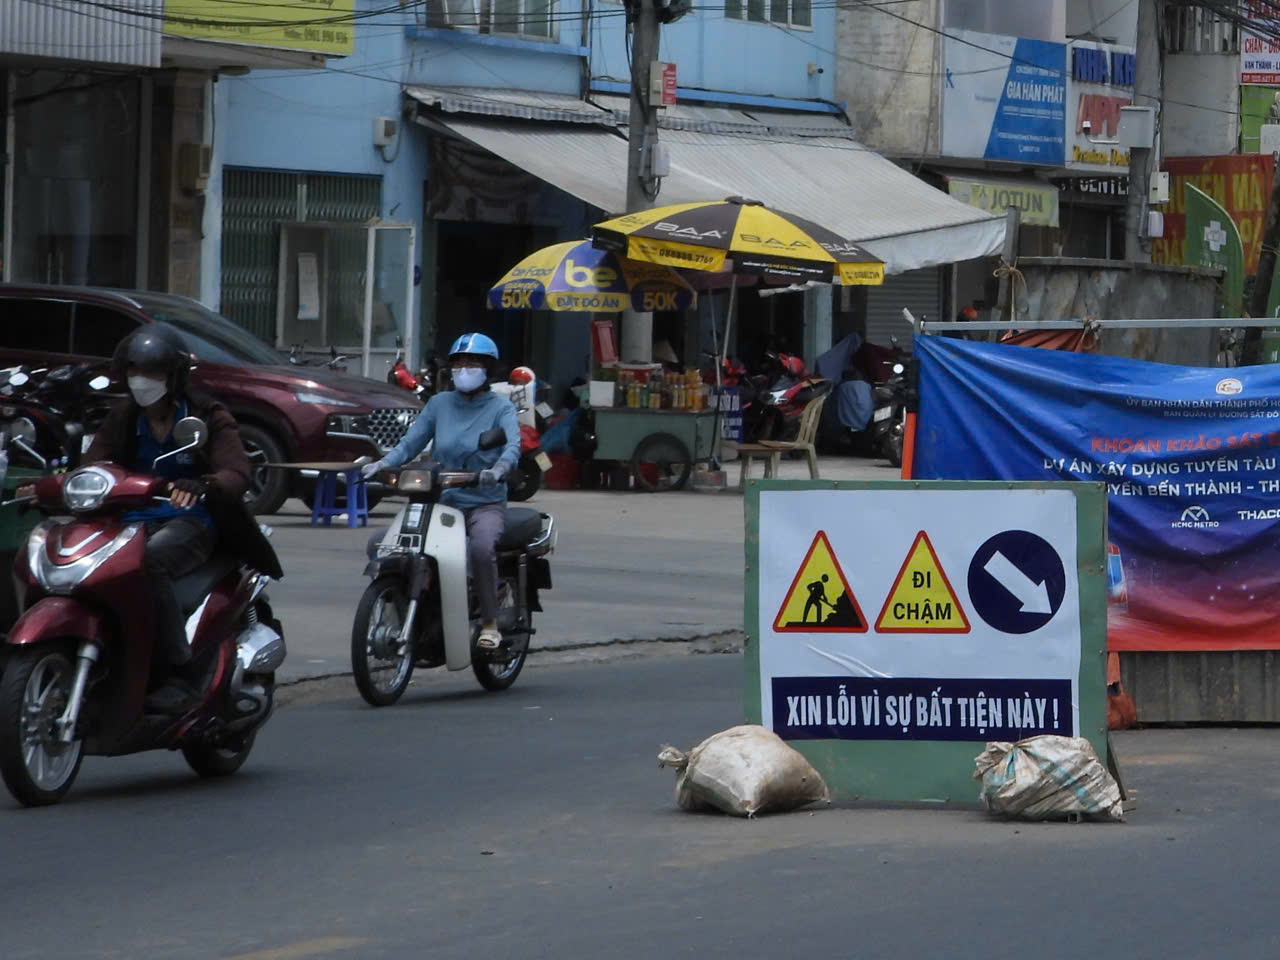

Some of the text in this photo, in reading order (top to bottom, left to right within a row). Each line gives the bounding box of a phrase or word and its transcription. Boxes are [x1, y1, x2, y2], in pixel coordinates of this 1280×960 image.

[1007, 81, 1021, 99] GIA
[991, 190, 1043, 213] JOTUN
[654, 222, 723, 239] BAA
[565, 259, 617, 289] be
[501, 290, 535, 310] 50K
[644, 291, 679, 311] 50K
[1141, 399, 1161, 407] BAN
[1092, 437, 1161, 453] KHOAN
[1166, 434, 1221, 451] KHẢO
[1044, 458, 1065, 472] DỰ
[1069, 460, 1092, 474] ÁN
[1096, 461, 1126, 476] XÂY
[1132, 460, 1180, 478] DỰNG
[1184, 455, 1238, 473] TUYẾN
[1243, 456, 1276, 471] TÀU
[1147, 480, 1180, 497] BẾN
[1184, 478, 1241, 497] THÀNH
[912, 570, 932, 589] ĐI
[893, 598, 952, 624] CHẬM
[787, 695, 822, 727] XIN
[826, 684, 857, 727] LỖI
[860, 689, 881, 727] VÌ
[885, 692, 913, 734] SỰ
[916, 687, 953, 728] BẤT
[957, 691, 1003, 735] TIỆN
[1008, 692, 1047, 730] NÀY
